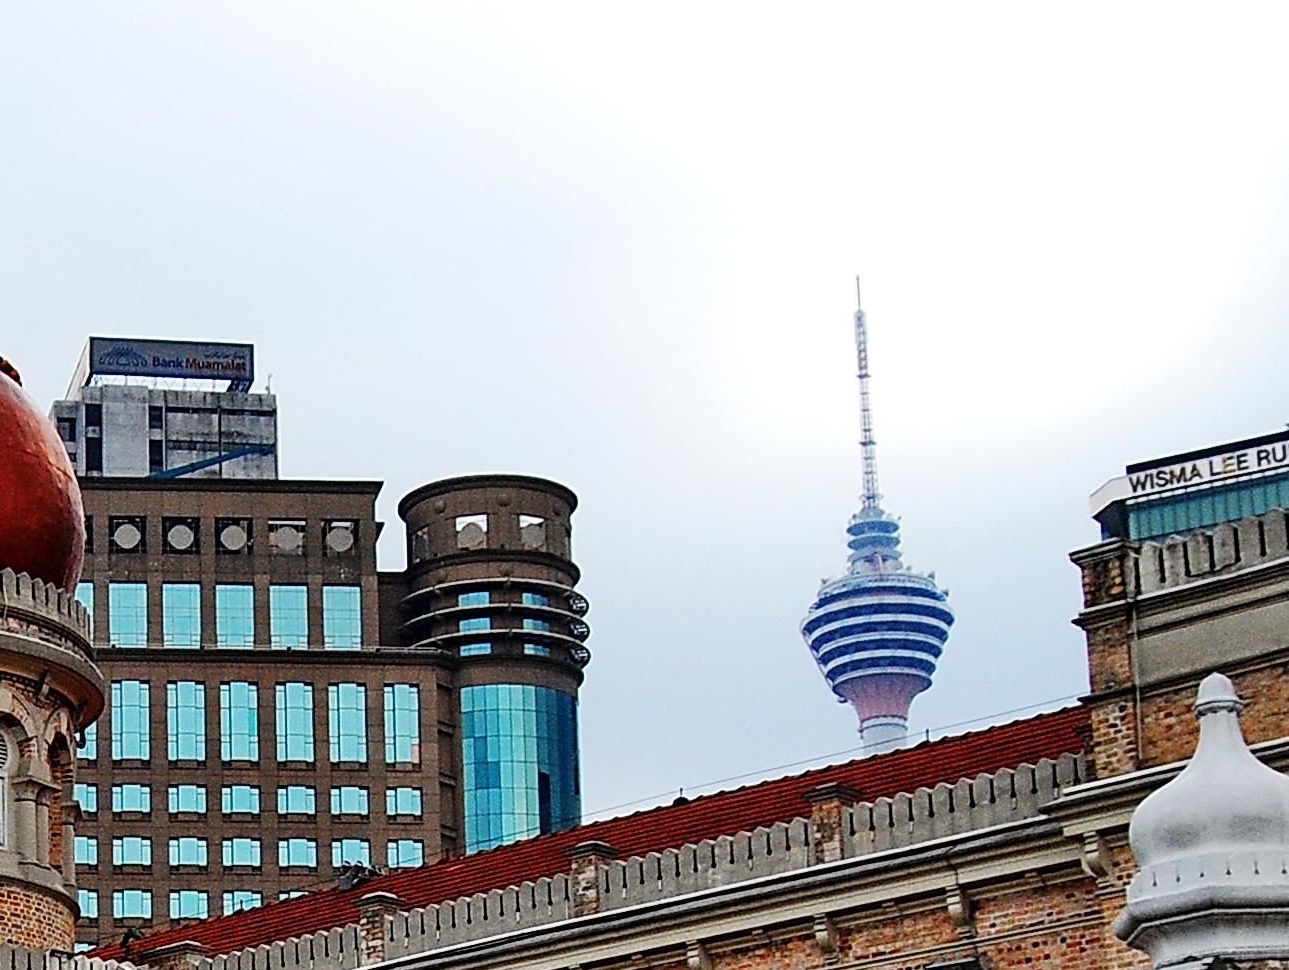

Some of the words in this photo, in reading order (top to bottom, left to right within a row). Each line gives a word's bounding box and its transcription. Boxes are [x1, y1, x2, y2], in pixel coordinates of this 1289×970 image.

[152, 356, 184, 369] Bank
[185, 357, 247, 372] Muamalat
[1128, 463, 1203, 493] WISMA
[1208, 452, 1250, 477] LEE
